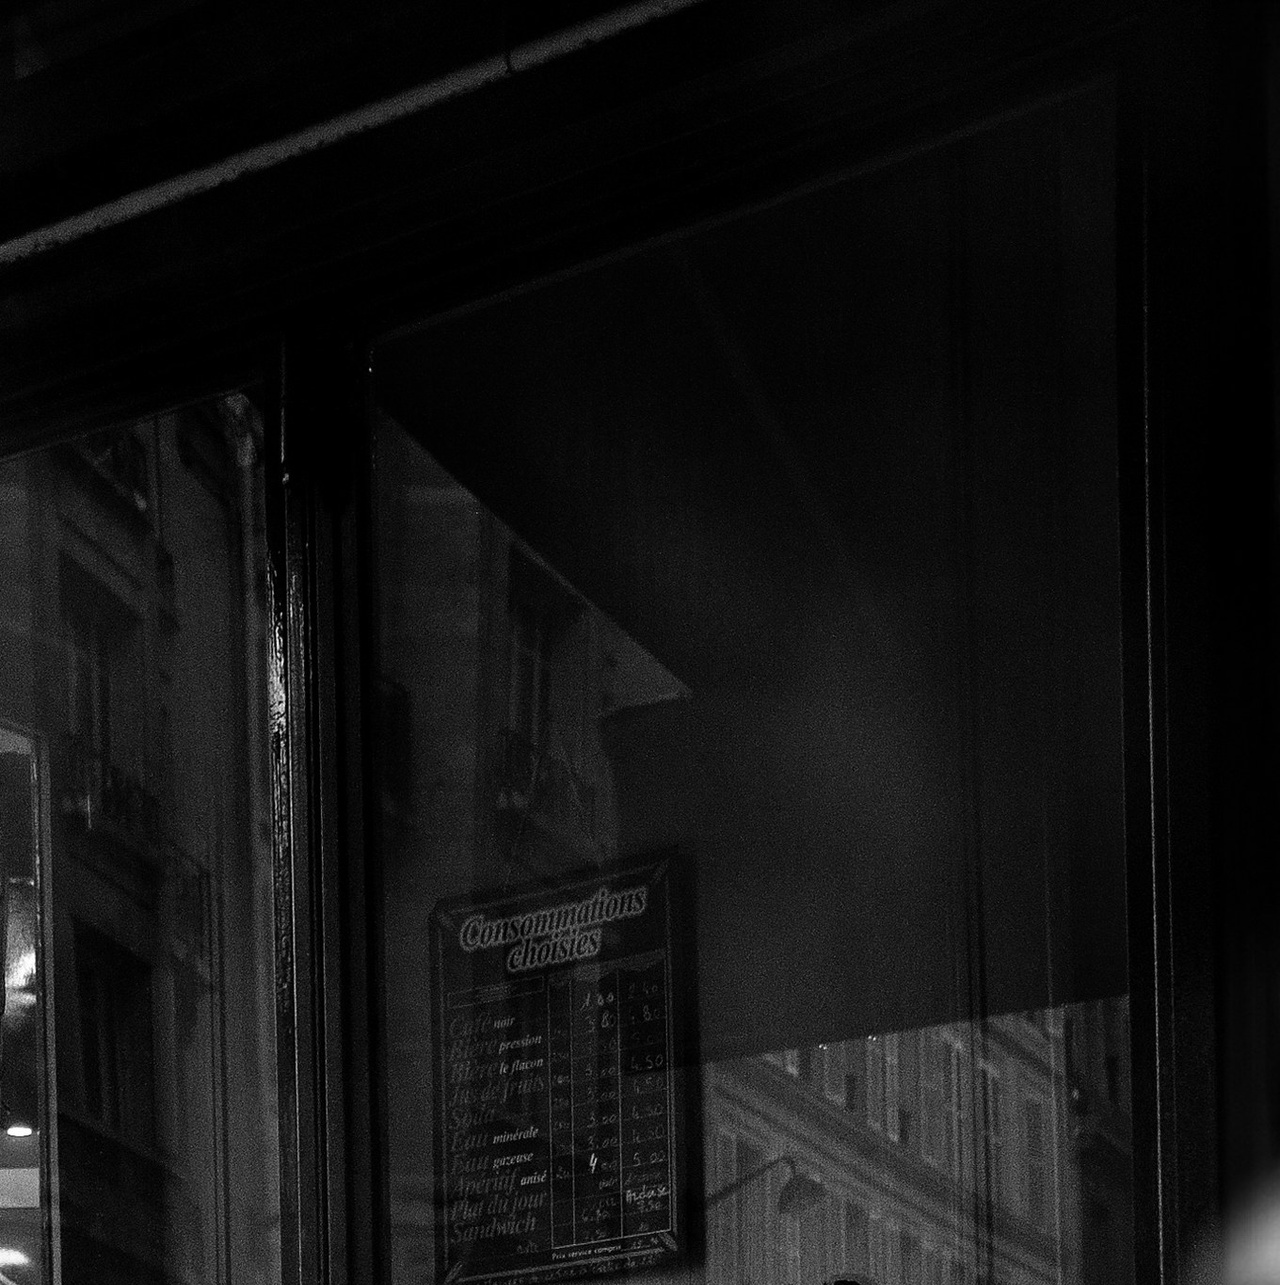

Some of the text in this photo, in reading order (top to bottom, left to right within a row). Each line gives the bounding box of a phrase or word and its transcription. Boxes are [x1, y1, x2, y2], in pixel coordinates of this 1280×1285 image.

[459, 885, 648, 952] Consommations
[506, 928, 602, 972] choisies
[449, 1012, 491, 1038] Café
[493, 1016, 515, 1028] noir
[449, 1036, 497, 1061] Bière
[498, 1034, 542, 1055] pression
[449, 1060, 498, 1084] Bière
[499, 1062, 509, 1074] le
[510, 1058, 543, 1075] flacon
[449, 1103, 495, 1130] Soda
[450, 1130, 488, 1152] Eau
[492, 1125, 539, 1144] minérale
[450, 1152, 489, 1175] Eau
[492, 1153, 534, 1169] gazeuse
[449, 1167, 547, 1200] Apéritif anisé
[487, 1193, 509, 1215] du
[508, 1191, 548, 1219] jour
[449, 1211, 537, 1243] Sandwich
